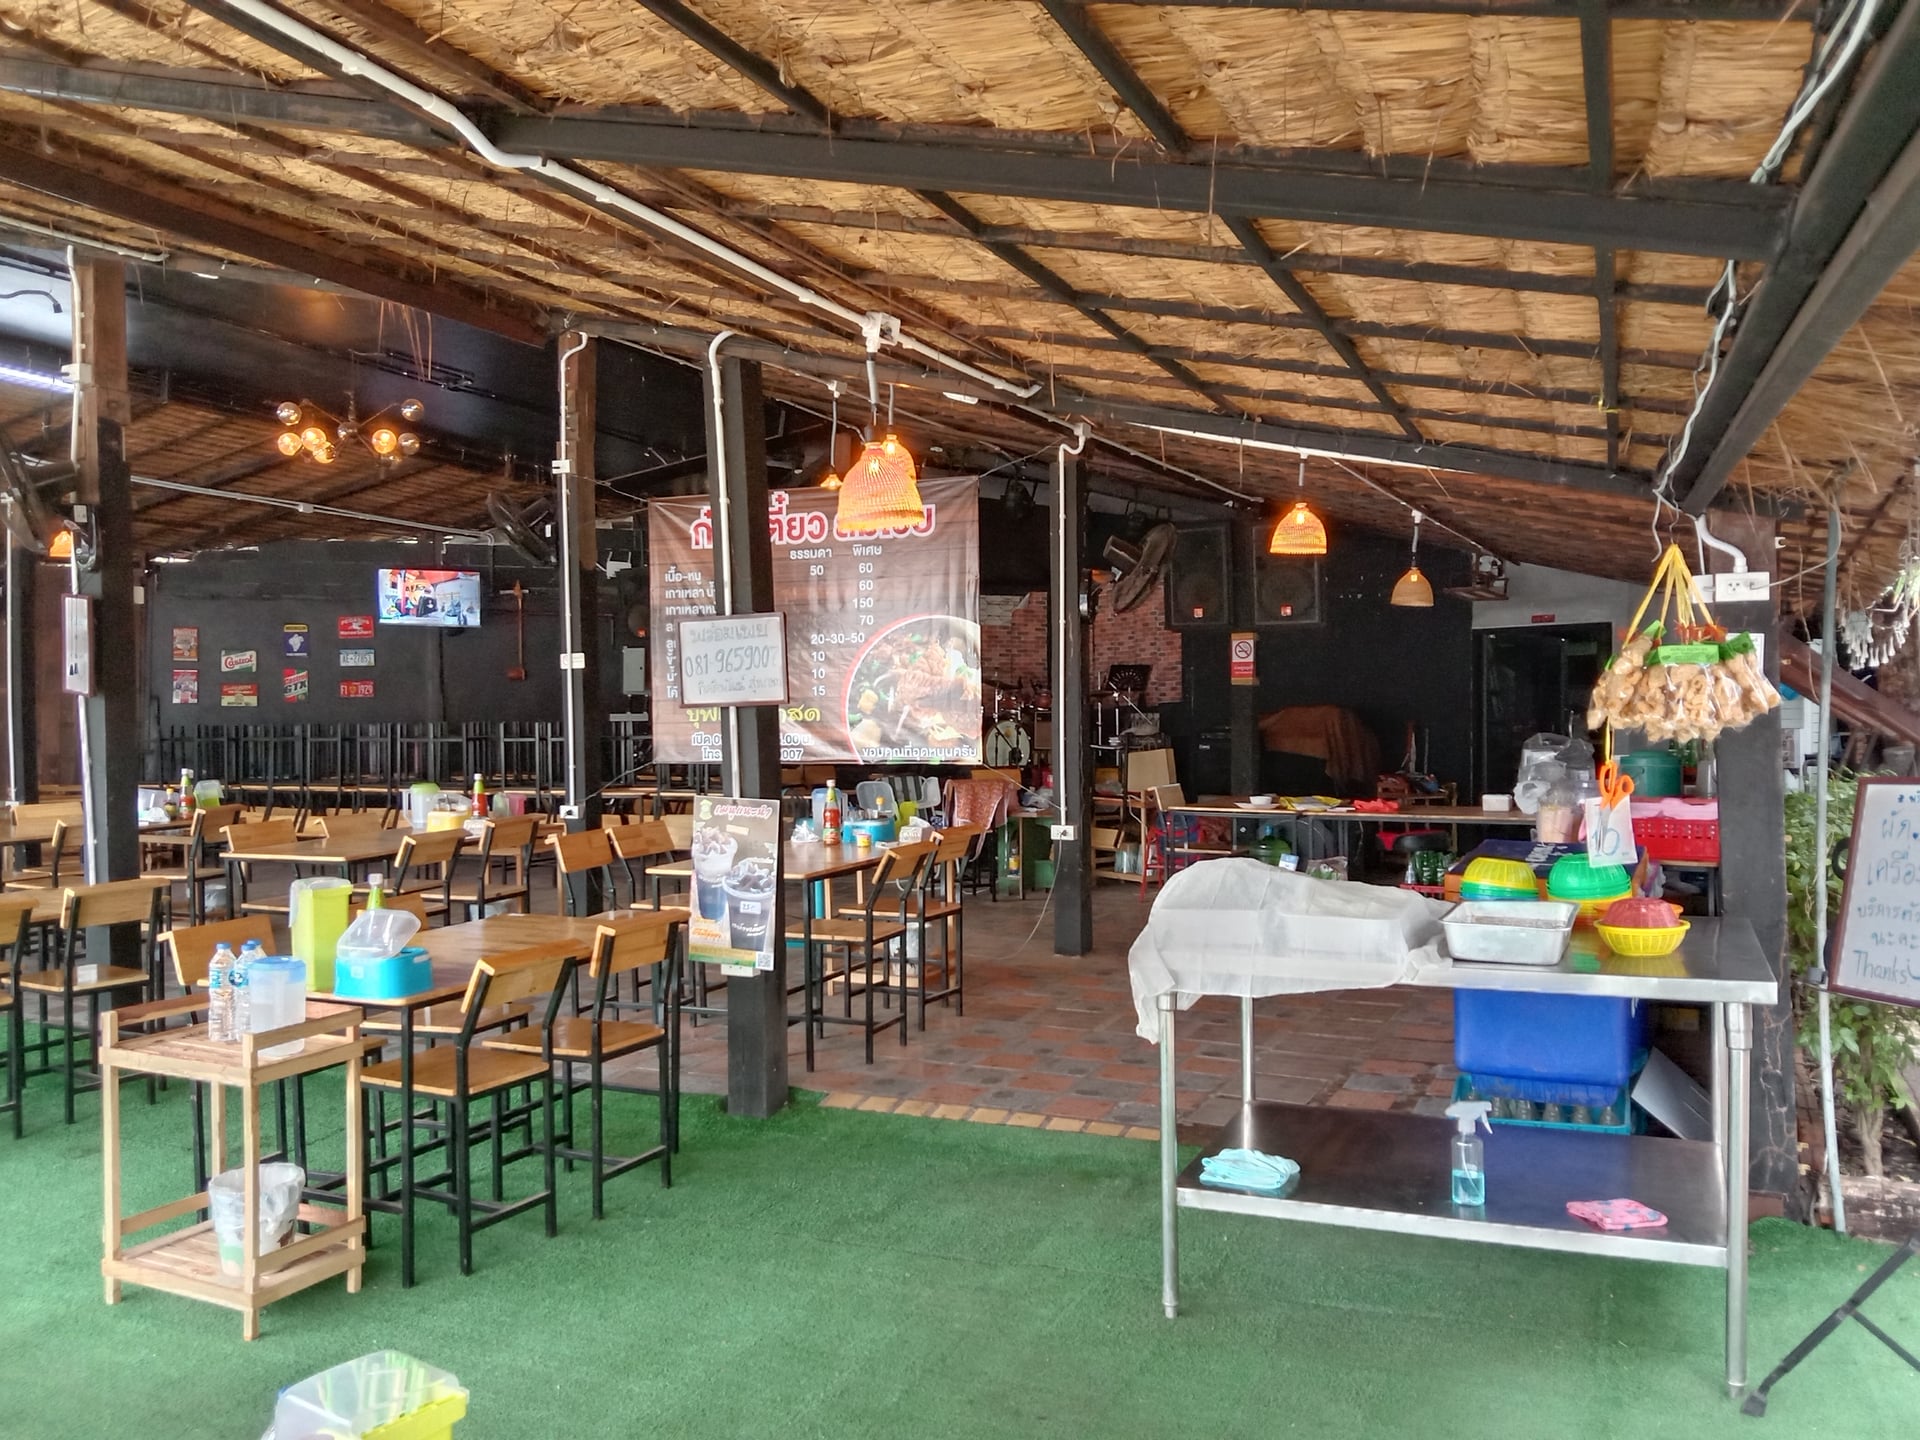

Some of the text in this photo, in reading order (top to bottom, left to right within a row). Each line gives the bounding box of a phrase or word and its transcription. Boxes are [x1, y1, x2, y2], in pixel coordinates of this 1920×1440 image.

[790, 544, 882, 560] ธรรมดา พิเศษ
[810, 565, 824, 576] 50
[859, 563, 873, 574] 60
[859, 580, 873, 590] 60
[852, 598, 873, 608] 150
[859, 615, 874, 625] 70
[811, 633, 865, 644] 20-30-50
[812, 651, 825, 661] 10
[812, 669, 825, 679] 10
[812, 686, 826, 696] 15
[1853, 949, 1908, 985] Thanks
